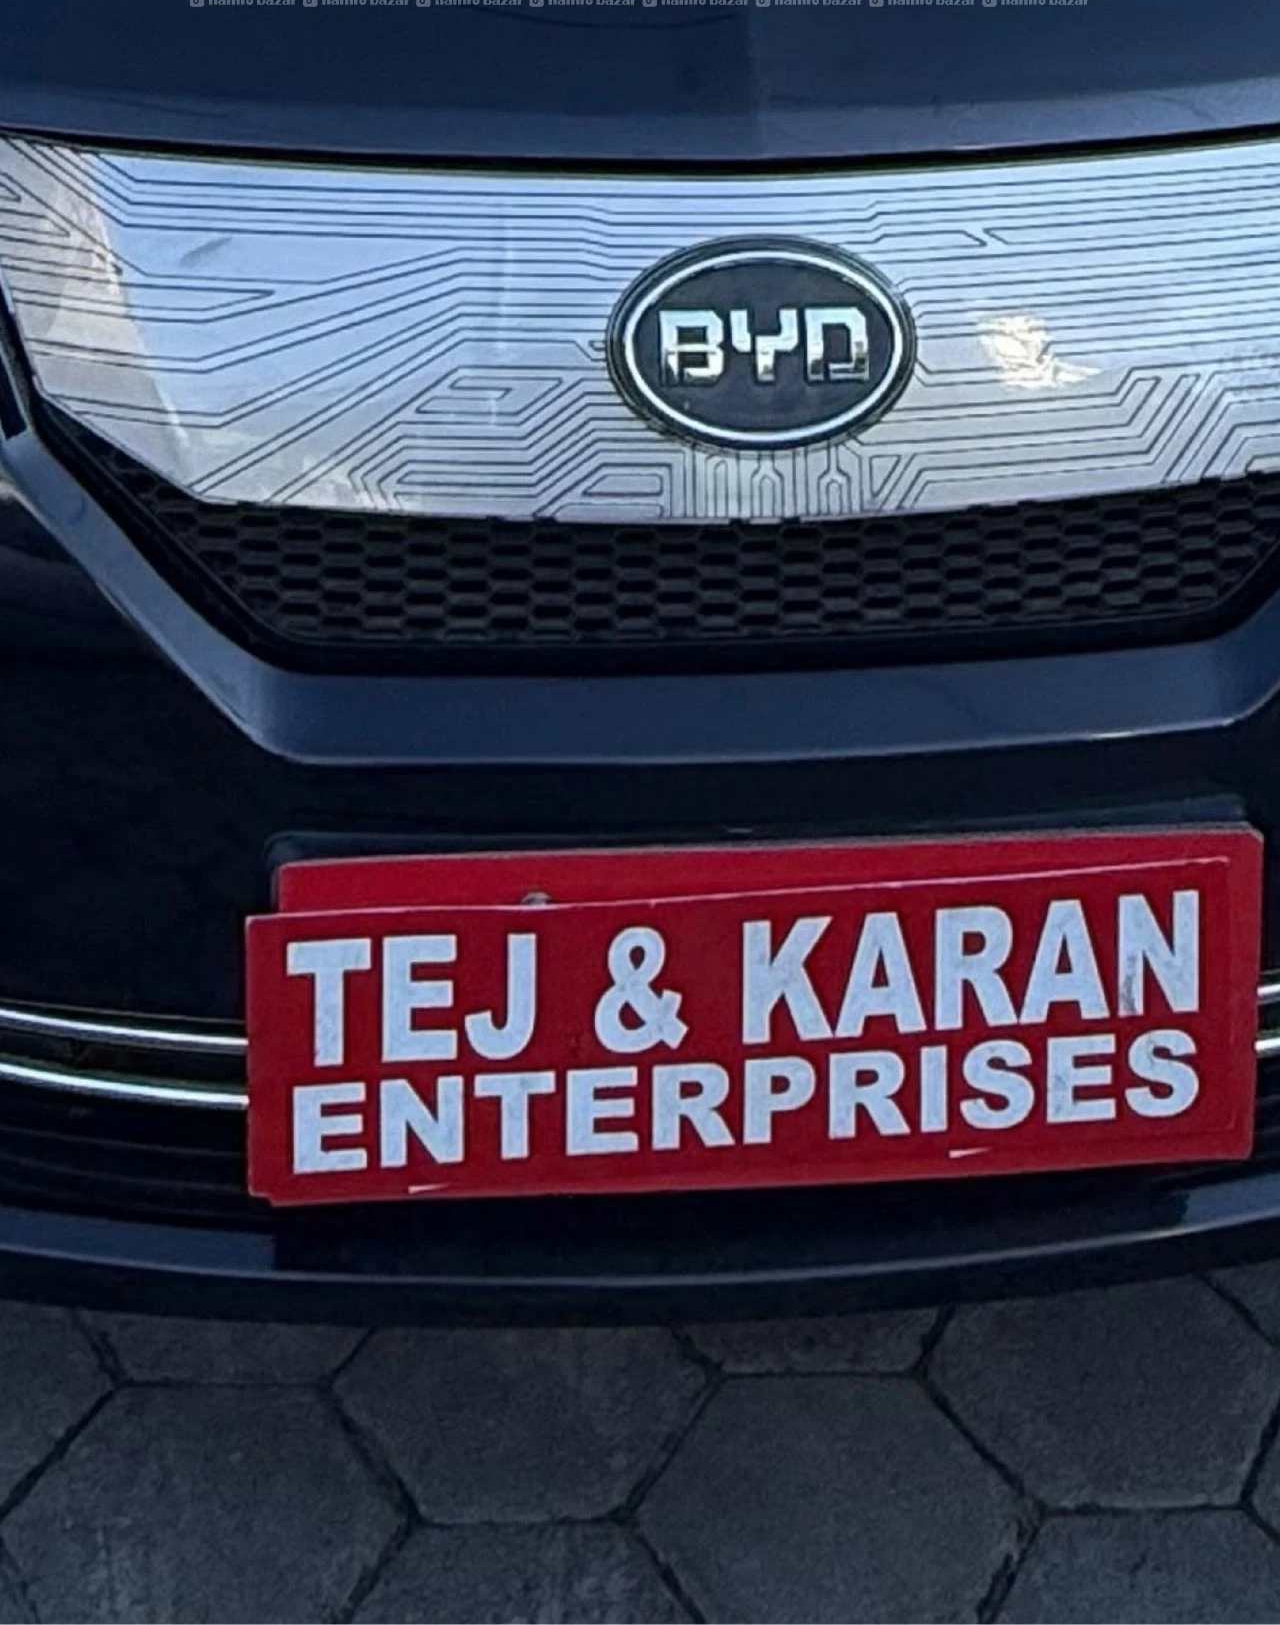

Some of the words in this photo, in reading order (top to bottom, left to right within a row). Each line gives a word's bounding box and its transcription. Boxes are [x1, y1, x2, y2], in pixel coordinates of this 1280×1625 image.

[658, 306, 870, 386] BYD
[285, 931, 538, 1067] TEJ
[593, 925, 689, 1054] &
[740, 888, 1201, 1046] KARAN
[291, 1028, 1200, 1173] ENTERPRISES
